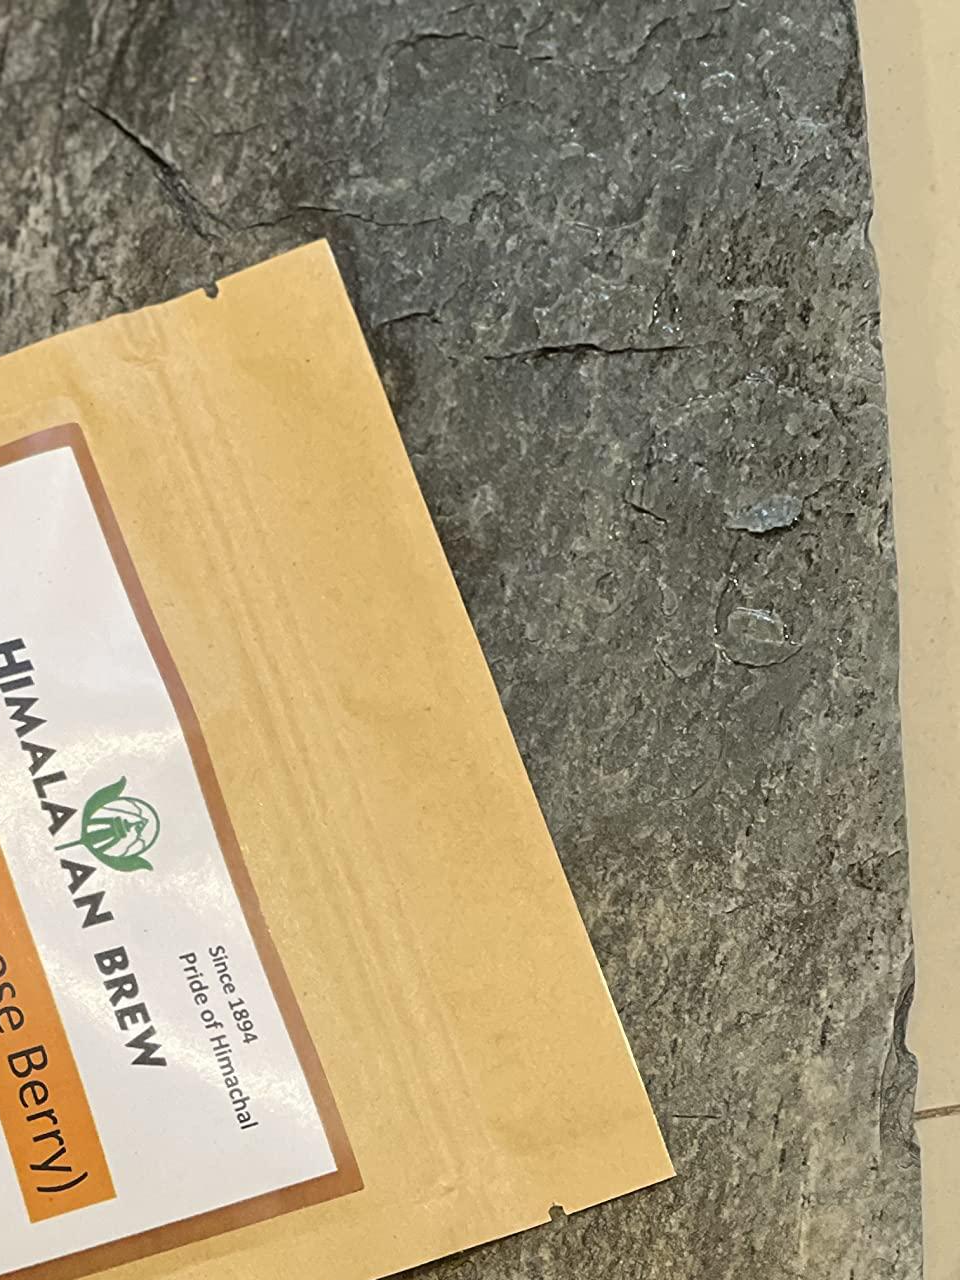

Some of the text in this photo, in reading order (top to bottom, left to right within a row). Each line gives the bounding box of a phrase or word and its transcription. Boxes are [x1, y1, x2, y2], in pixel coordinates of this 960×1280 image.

[93, 946, 167, 1067] BREW
[179, 952, 259, 1130] Pride of Himachal
[209, 945, 258, 1044] Since 1894
[7, 1044, 88, 1193] Berry)
